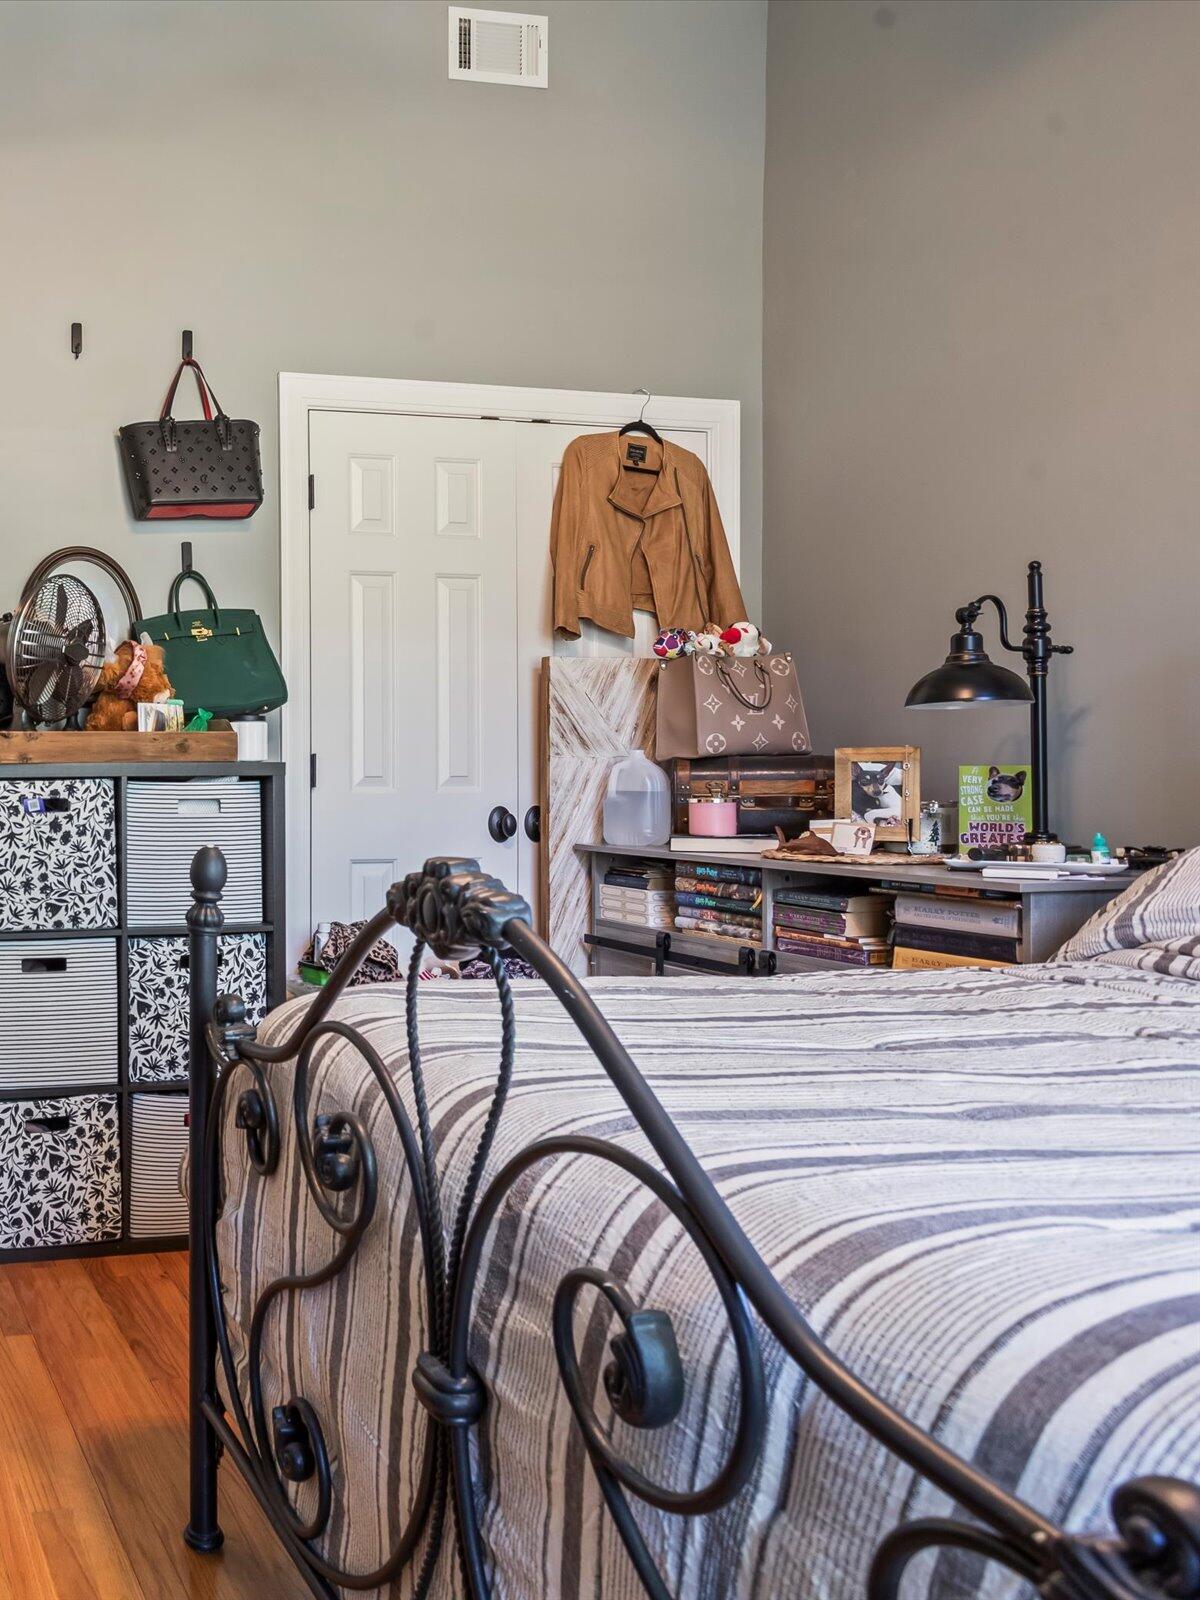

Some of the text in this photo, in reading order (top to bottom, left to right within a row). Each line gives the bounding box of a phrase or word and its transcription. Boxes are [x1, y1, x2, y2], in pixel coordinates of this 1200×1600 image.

[962, 775, 983, 784] VERY
[960, 785, 983, 795] STRONG
[960, 795, 984, 806] CASE
[969, 822, 1025, 833] WORLD'S
[960, 832, 1025, 844] GREATES
[914, 905, 945, 915] HARRY
[912, 957, 942, 967] HARRY
